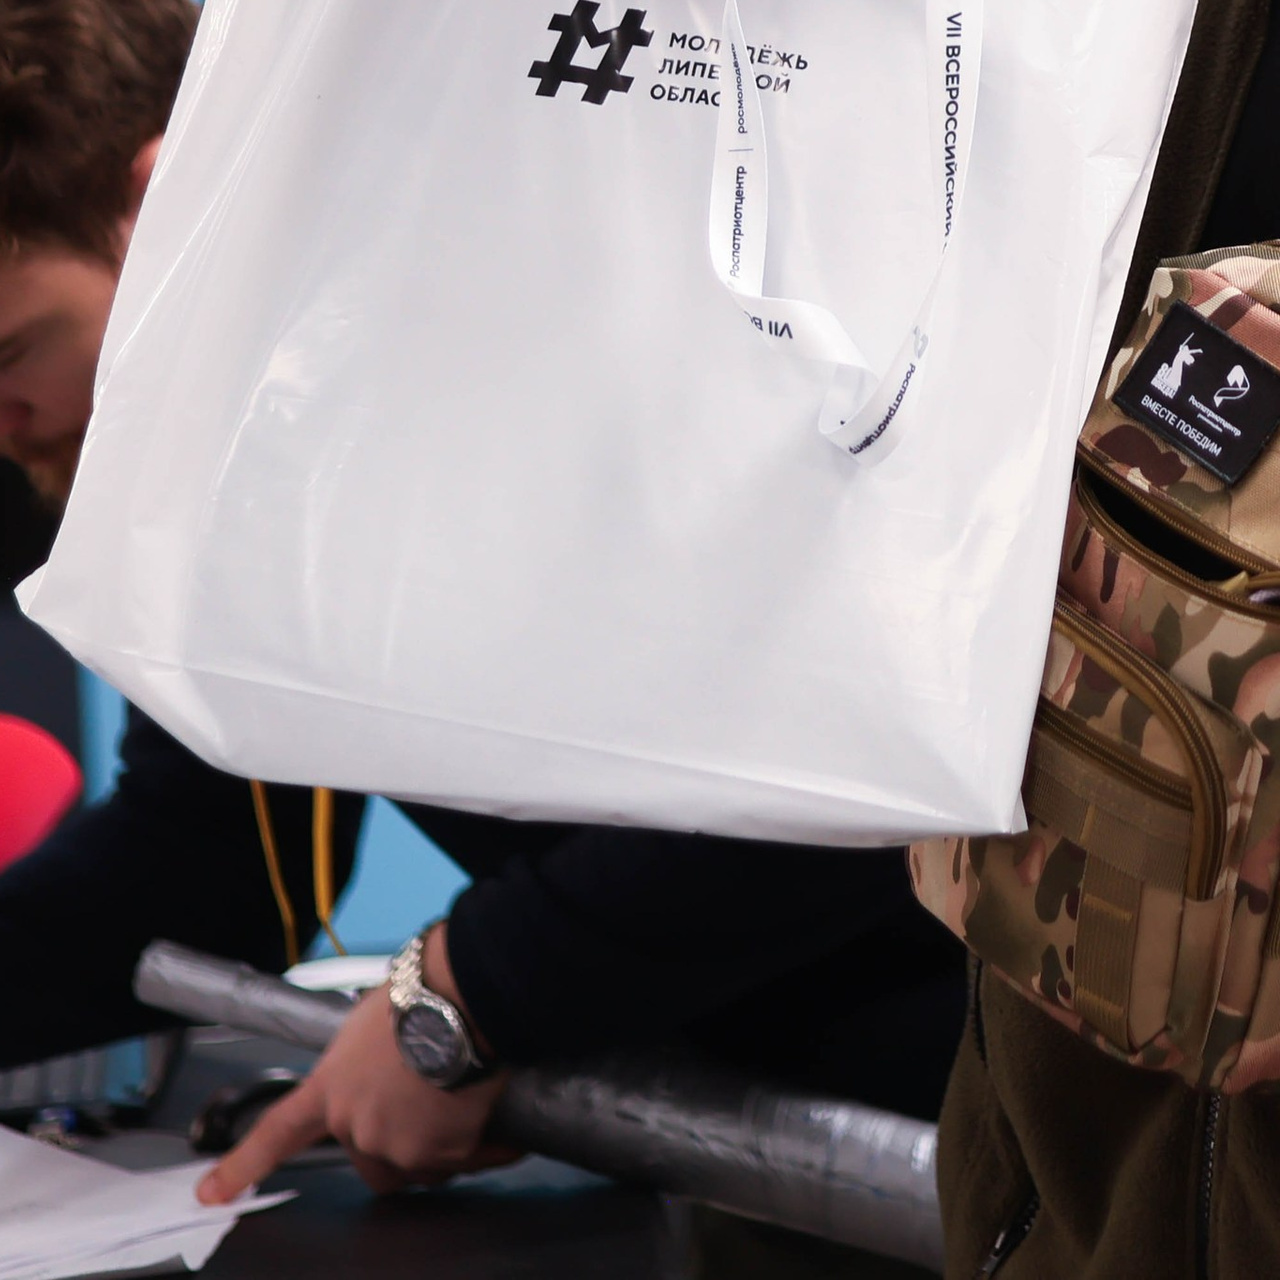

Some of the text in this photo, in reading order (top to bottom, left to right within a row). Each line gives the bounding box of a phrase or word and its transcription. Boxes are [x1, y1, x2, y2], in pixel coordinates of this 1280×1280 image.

[946, 12, 962, 38] VII
[669, 32, 809, 70] МОЛЁЖЬ
[658, 58, 791, 94] ЛИПЕОЙ
[650, 84, 721, 107] ОБЛАС
[729, 165, 748, 278] Роспатриотцентр
[1140, 394, 1178, 425] ВМЕСТЕ
[1175, 419, 1223, 457] ПОБЕДИМ
